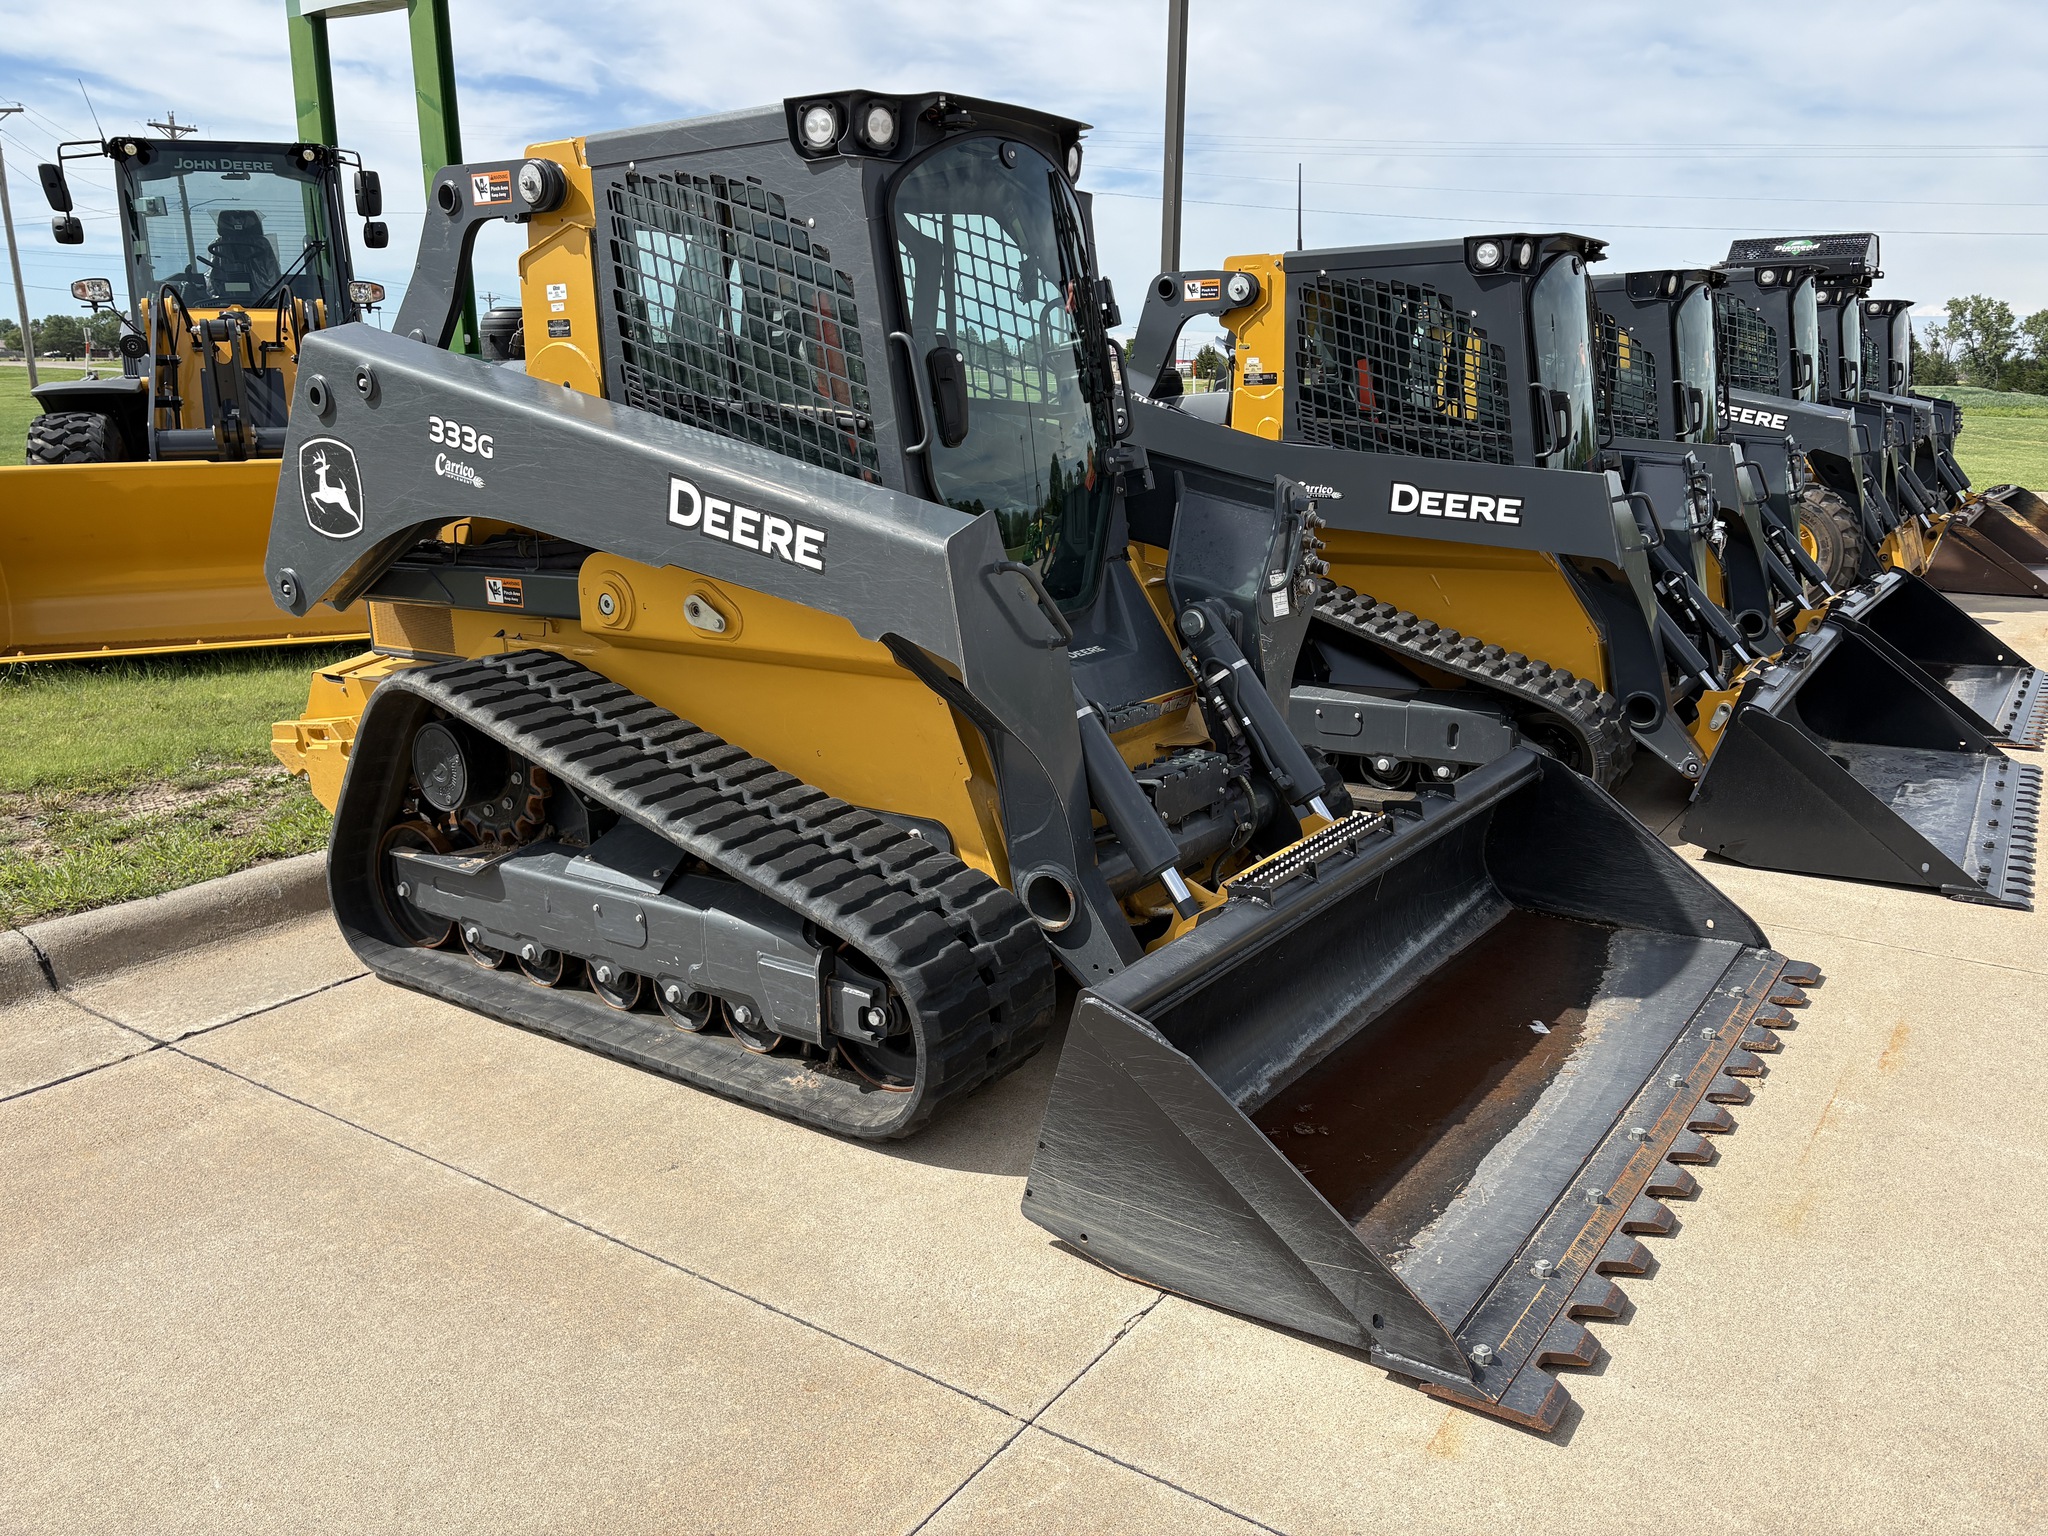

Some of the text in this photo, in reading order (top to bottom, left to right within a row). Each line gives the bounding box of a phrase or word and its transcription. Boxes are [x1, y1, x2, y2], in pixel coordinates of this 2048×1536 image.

[174, 158, 274, 171] JOHN DEERE
[429, 415, 494, 459] 333G
[435, 453, 474, 478] Carrico
[1390, 483, 1523, 524] DEERE
[668, 477, 826, 571] DEERE
[1068, 646, 1106, 659] DEERE
